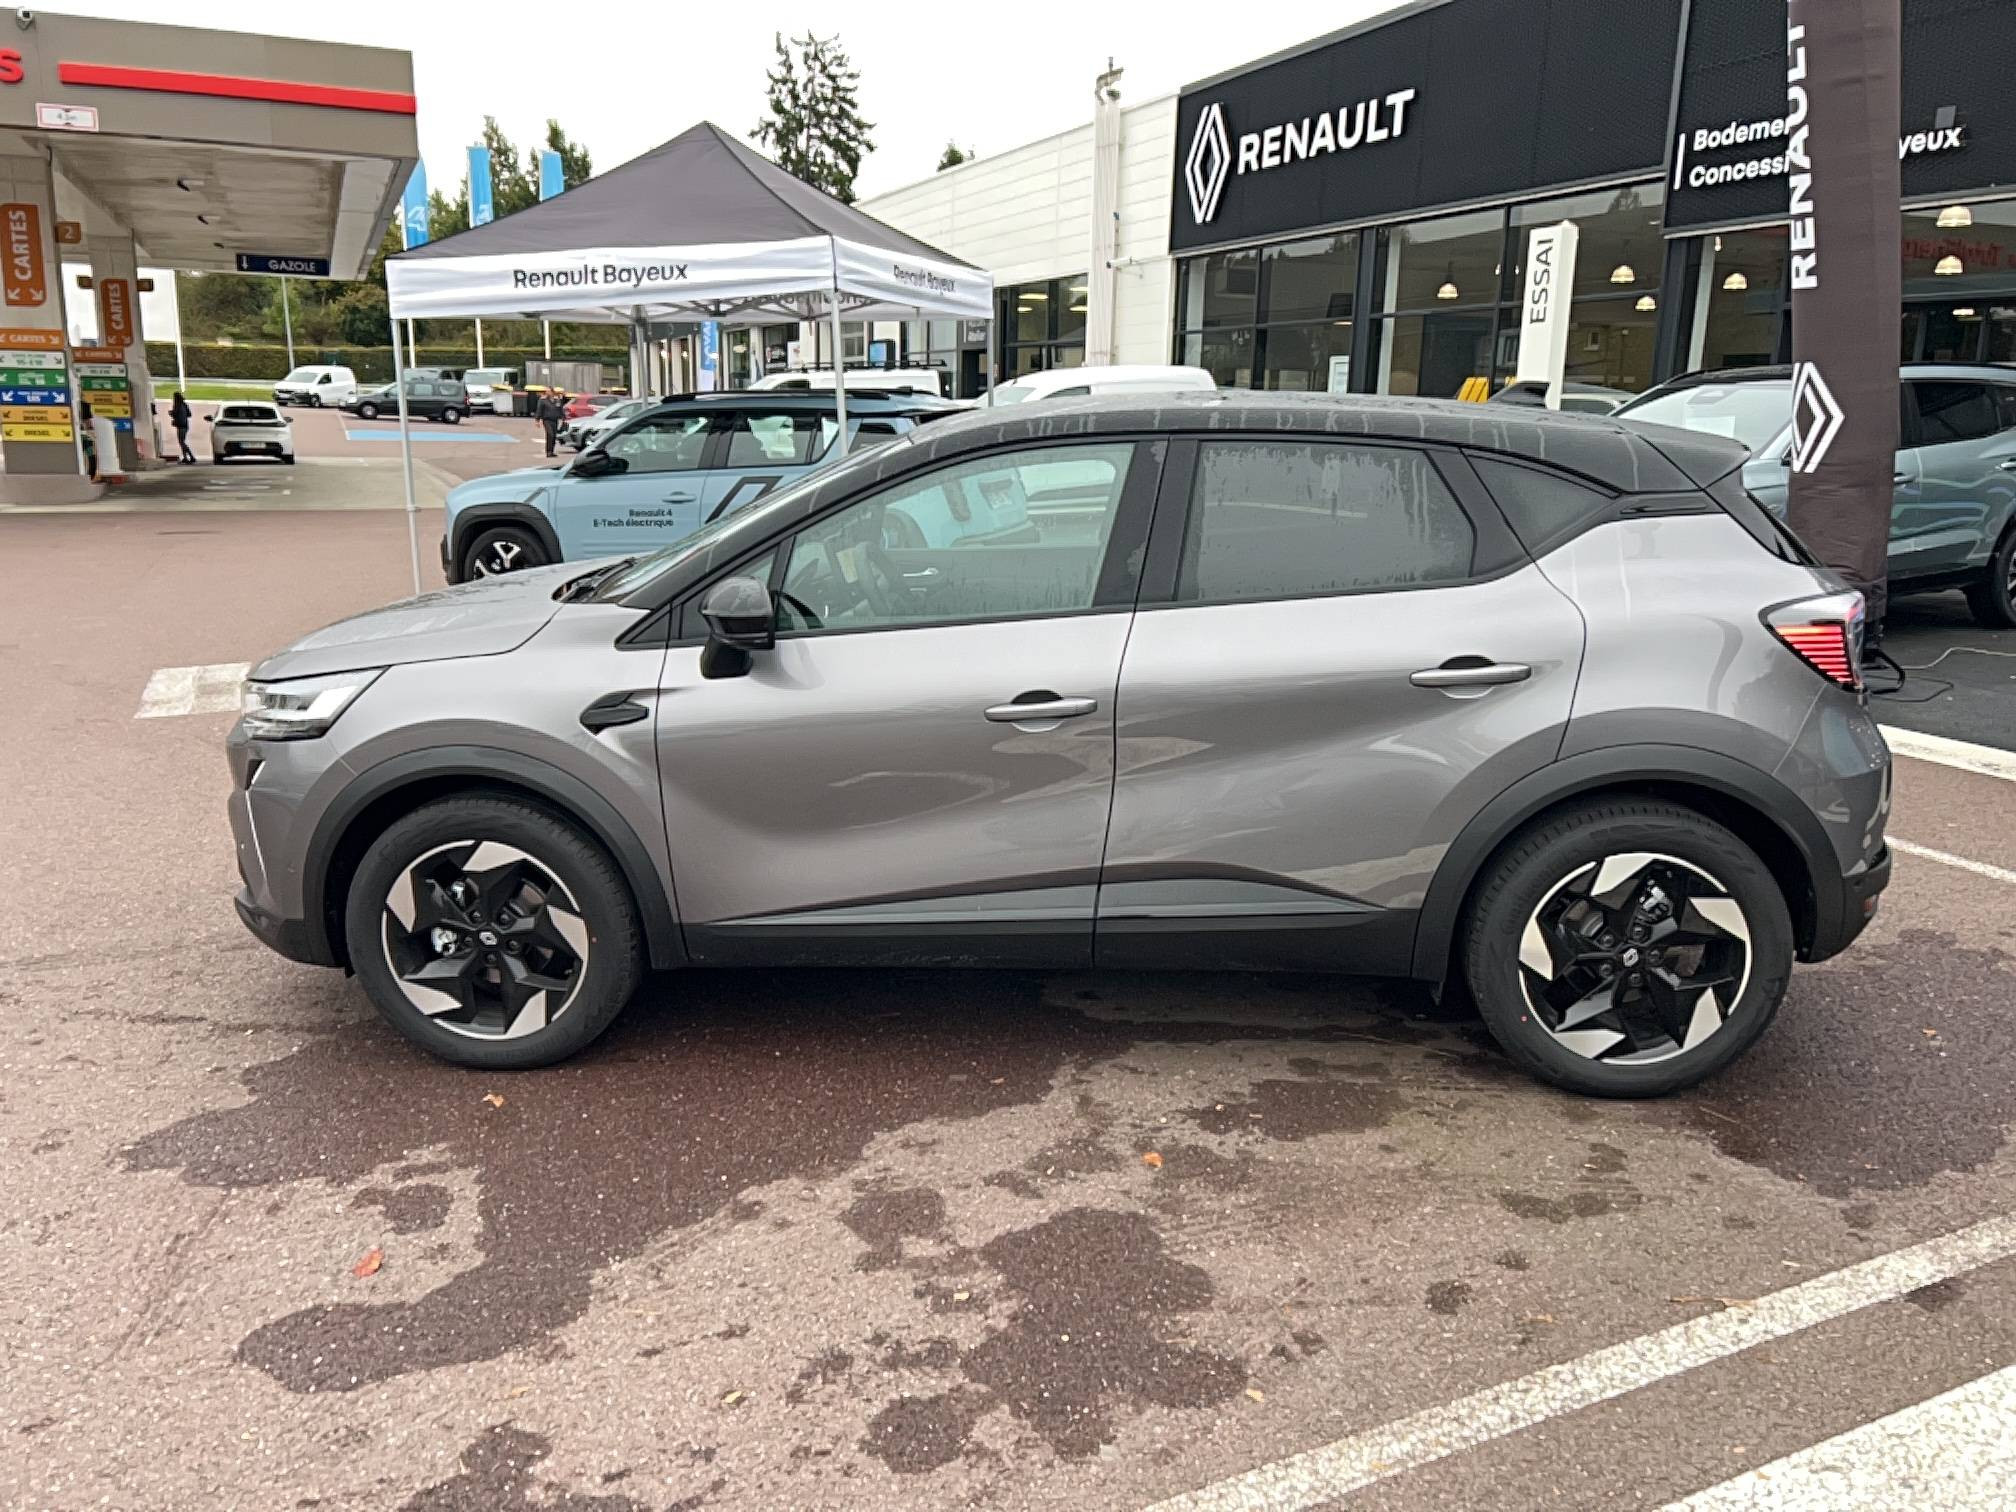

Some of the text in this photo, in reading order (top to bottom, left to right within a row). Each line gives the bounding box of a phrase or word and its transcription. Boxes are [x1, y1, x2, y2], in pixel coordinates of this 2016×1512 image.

[1237, 87, 1416, 175] RENAULT
[1689, 126, 1963, 187] Concessi yeux
[1787, 17, 1818, 289] RENAULT
[8, 209, 32, 281] CARTES
[64, 226, 75, 239] 2
[268, 259, 316, 272] GAZOLE
[513, 263, 688, 288] Renault Bayeux
[893, 264, 956, 295] Renault Bayeux
[1529, 238, 1554, 324] ESSAI
[107, 283, 124, 330] CARTES
[9, 334, 46, 344] CARTES
[593, 518, 674, 528] E-Tech électrique
[629, 508, 673, 517] Renault 4
